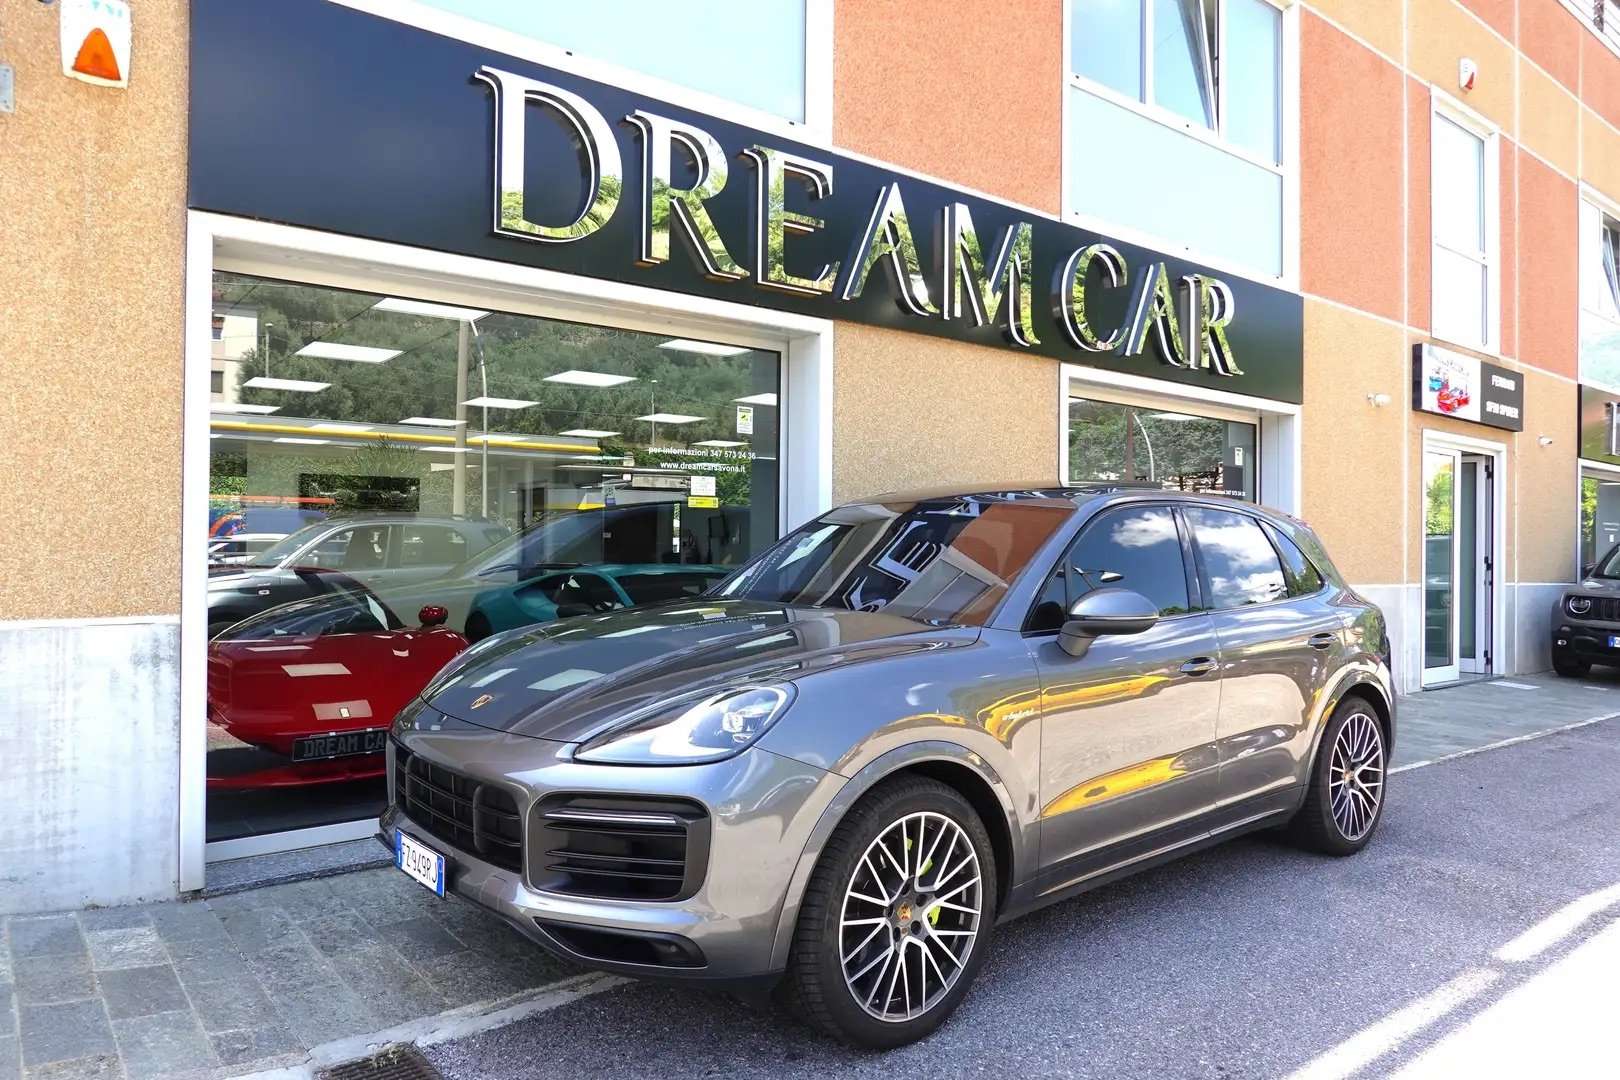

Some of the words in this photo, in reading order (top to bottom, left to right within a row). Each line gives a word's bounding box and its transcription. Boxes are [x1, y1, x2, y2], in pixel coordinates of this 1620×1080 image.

[474, 65, 1041, 346] DREAM
[1061, 243, 1245, 376] CAR
[663, 446, 709, 457] informazioni
[710, 449, 722, 458] 347
[725, 450, 737, 459] 573
[660, 461, 745, 473] www.dreamcarsavona.it
[303, 735, 358, 758] DREAM
[364, 731, 386, 749] CA
